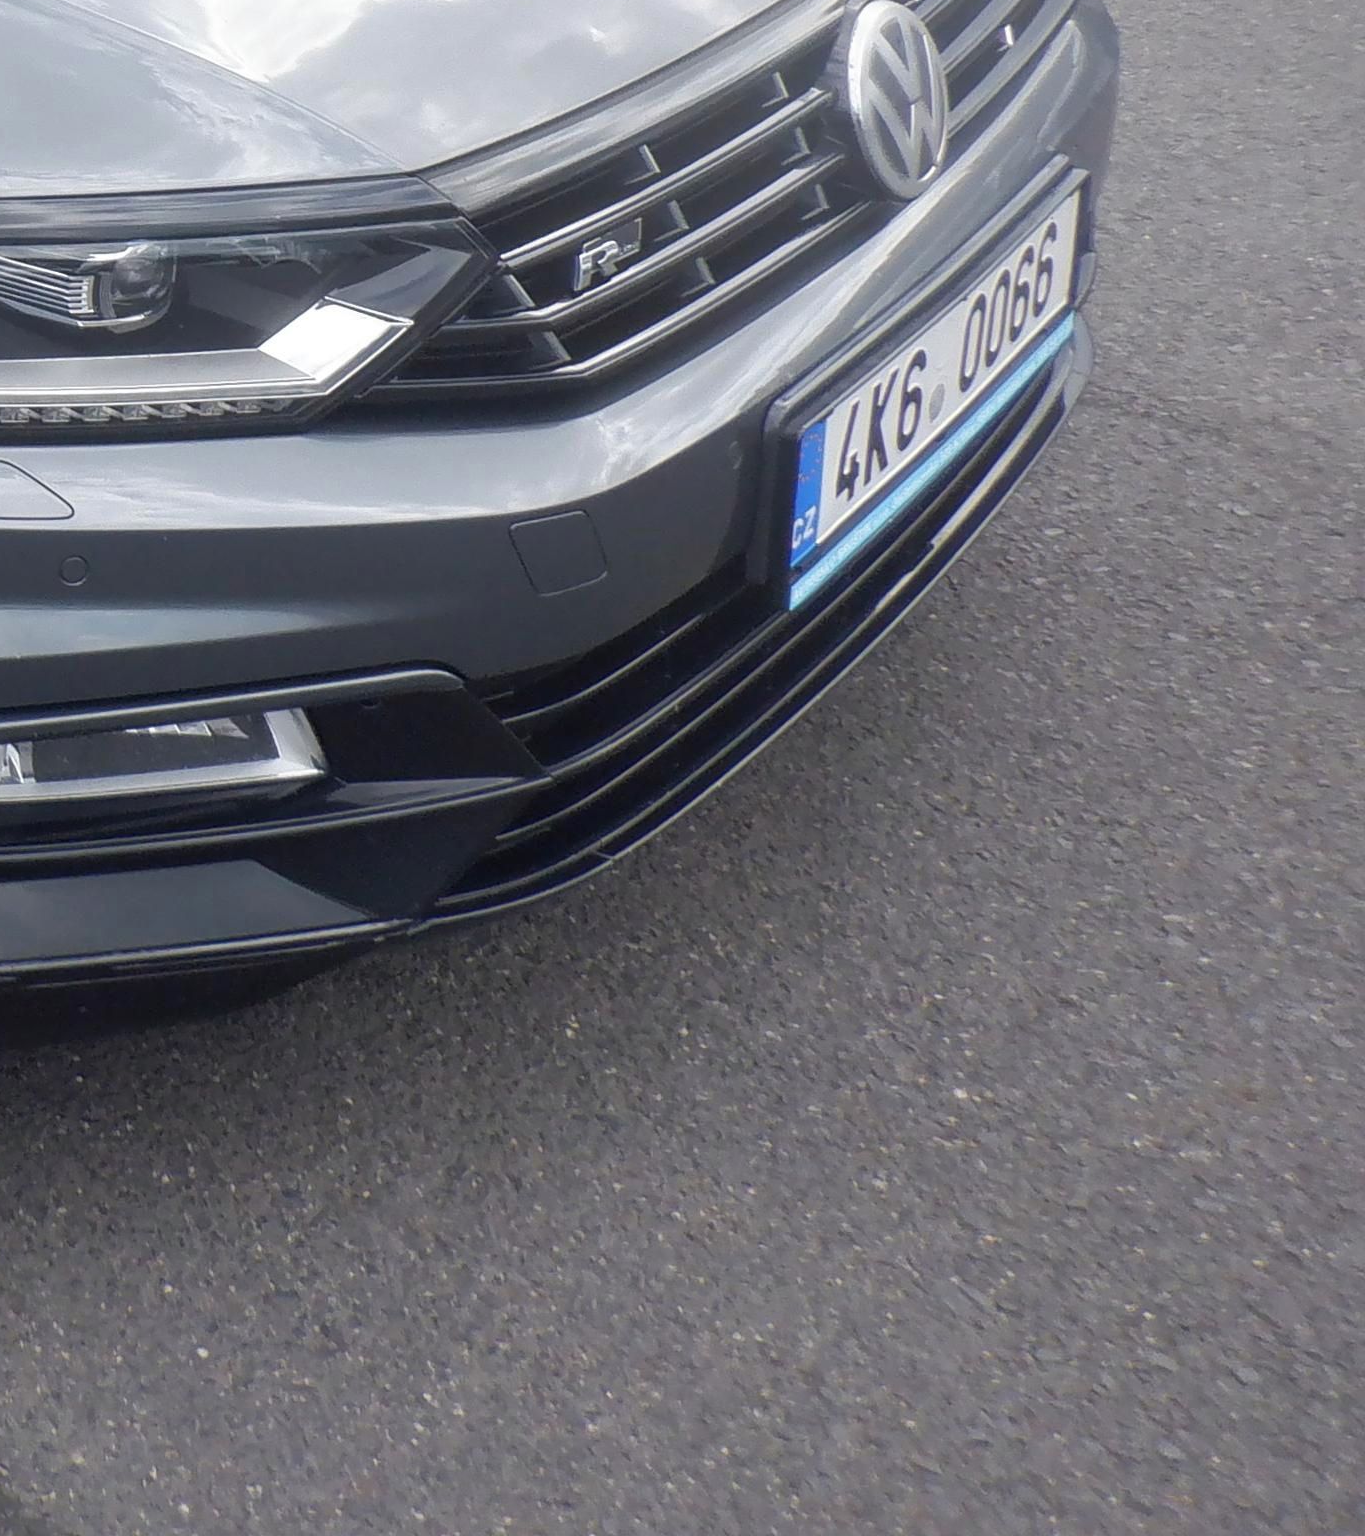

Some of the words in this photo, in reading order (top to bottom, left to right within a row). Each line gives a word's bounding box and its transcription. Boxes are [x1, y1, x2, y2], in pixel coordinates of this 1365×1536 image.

[834, 349, 928, 502] 4K6
[957, 221, 1057, 394] 0066
[792, 504, 817, 550] CZ
